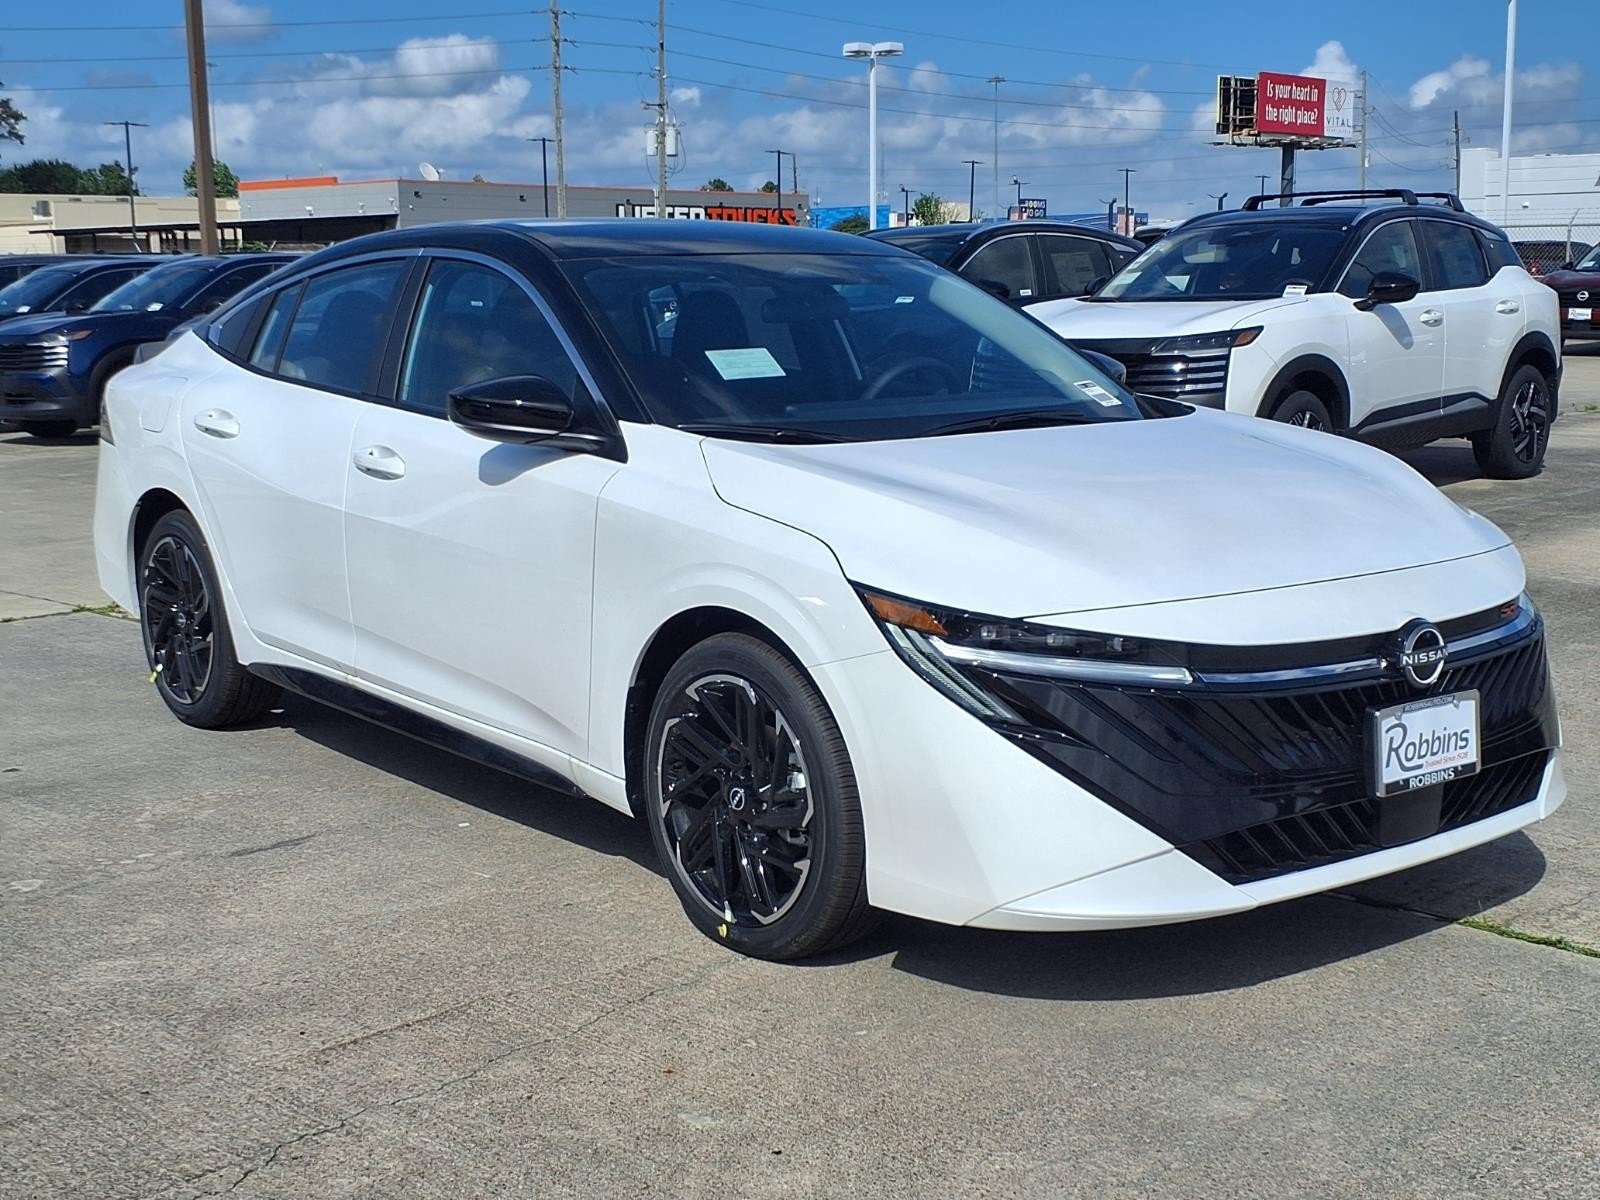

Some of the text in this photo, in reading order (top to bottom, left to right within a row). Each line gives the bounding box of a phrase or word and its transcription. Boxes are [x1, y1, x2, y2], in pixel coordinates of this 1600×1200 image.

[1267, 80, 1318, 102] Is your heart in
[1265, 103, 1318, 126] the right place?
[1326, 116, 1351, 128] VITAL
[1402, 648, 1448, 665] NISSAN
[1385, 722, 1470, 772] Robbins
[1409, 768, 1455, 789] ROBBINS
